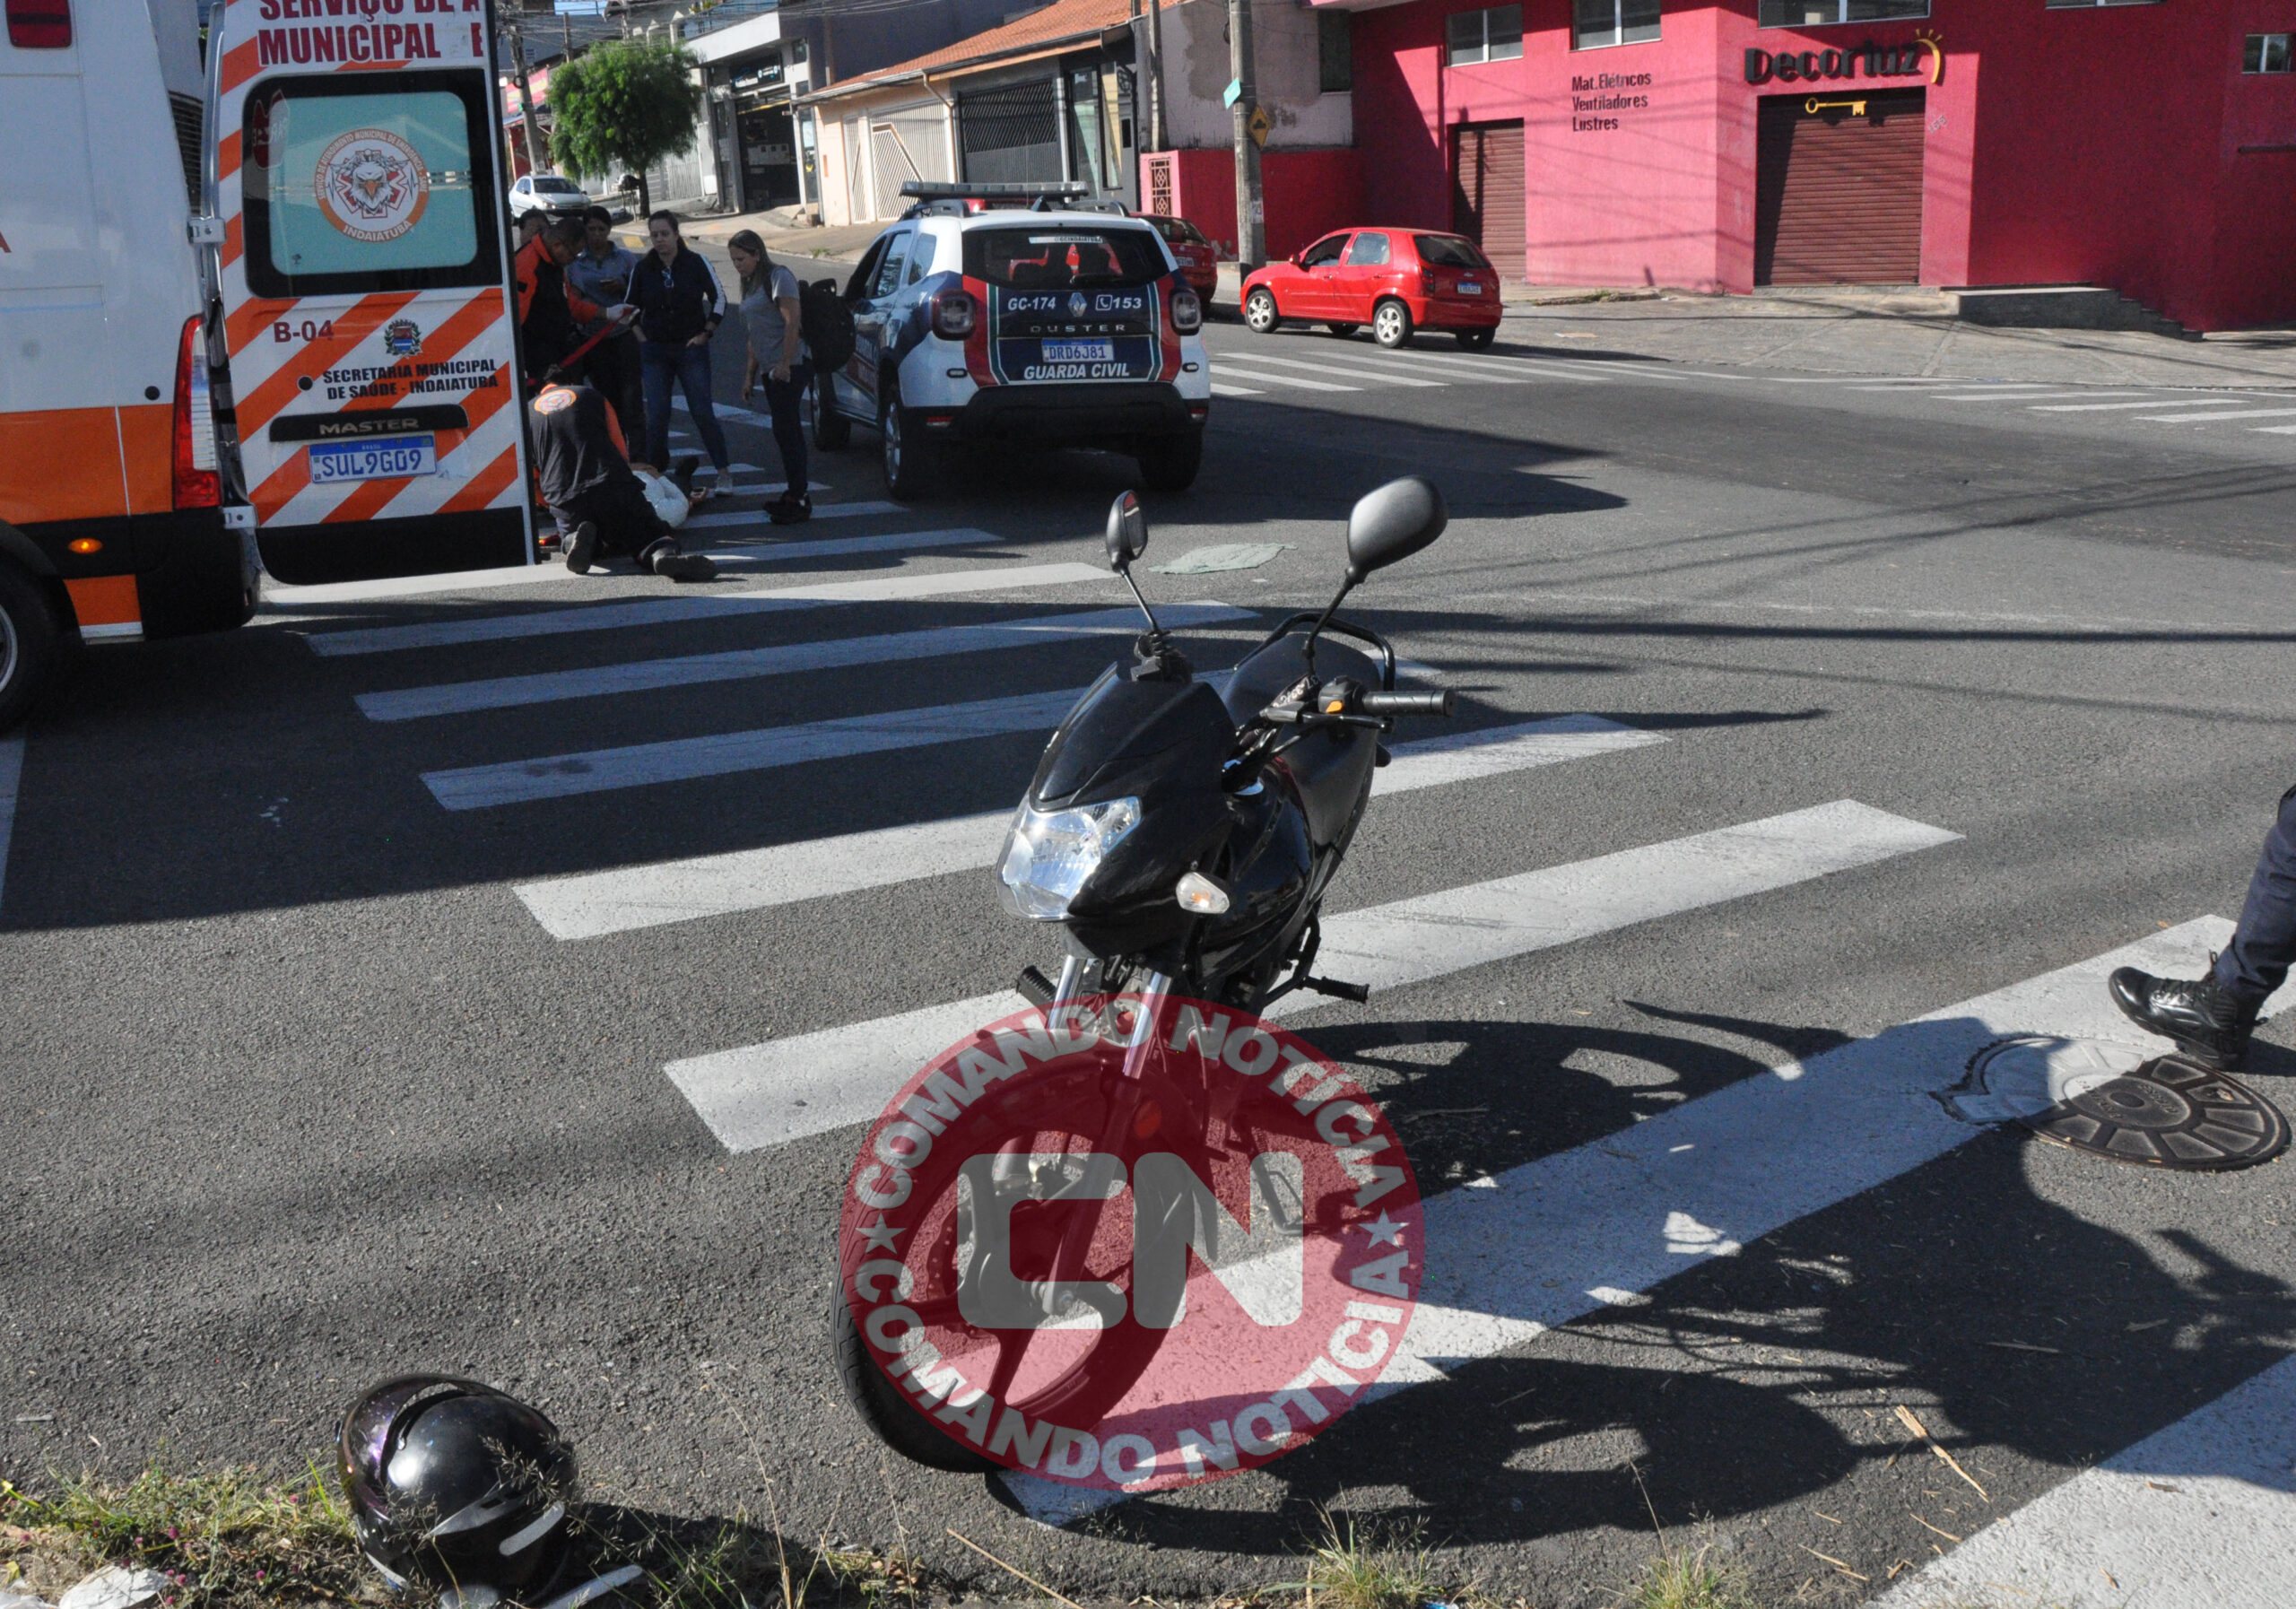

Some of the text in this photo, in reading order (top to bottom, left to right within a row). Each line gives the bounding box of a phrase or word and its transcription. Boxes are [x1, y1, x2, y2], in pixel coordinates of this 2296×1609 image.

[258, 22, 441, 65] MUNICIPAL
[1572, 93, 1648, 112] Ventiladores
[1572, 116, 1619, 132] Lustres
[343, 220, 413, 241] INDAIATUBA
[1007, 297, 1057, 311] GC-174
[1112, 297, 1142, 309] 153
[273, 319, 335, 344] B-04
[1030, 323, 1126, 333] DUSTER
[1048, 346, 1107, 360] DRD6J81
[323, 359, 497, 384] SECRETARIA MUNICIPAL
[1023, 361, 1130, 380] GUARDA CIVIL
[327, 387, 345, 400] DE
[410, 375, 499, 395] INDAIATUBA
[318, 418, 419, 436] MASTER
[321, 449, 422, 477] SUL9G09
